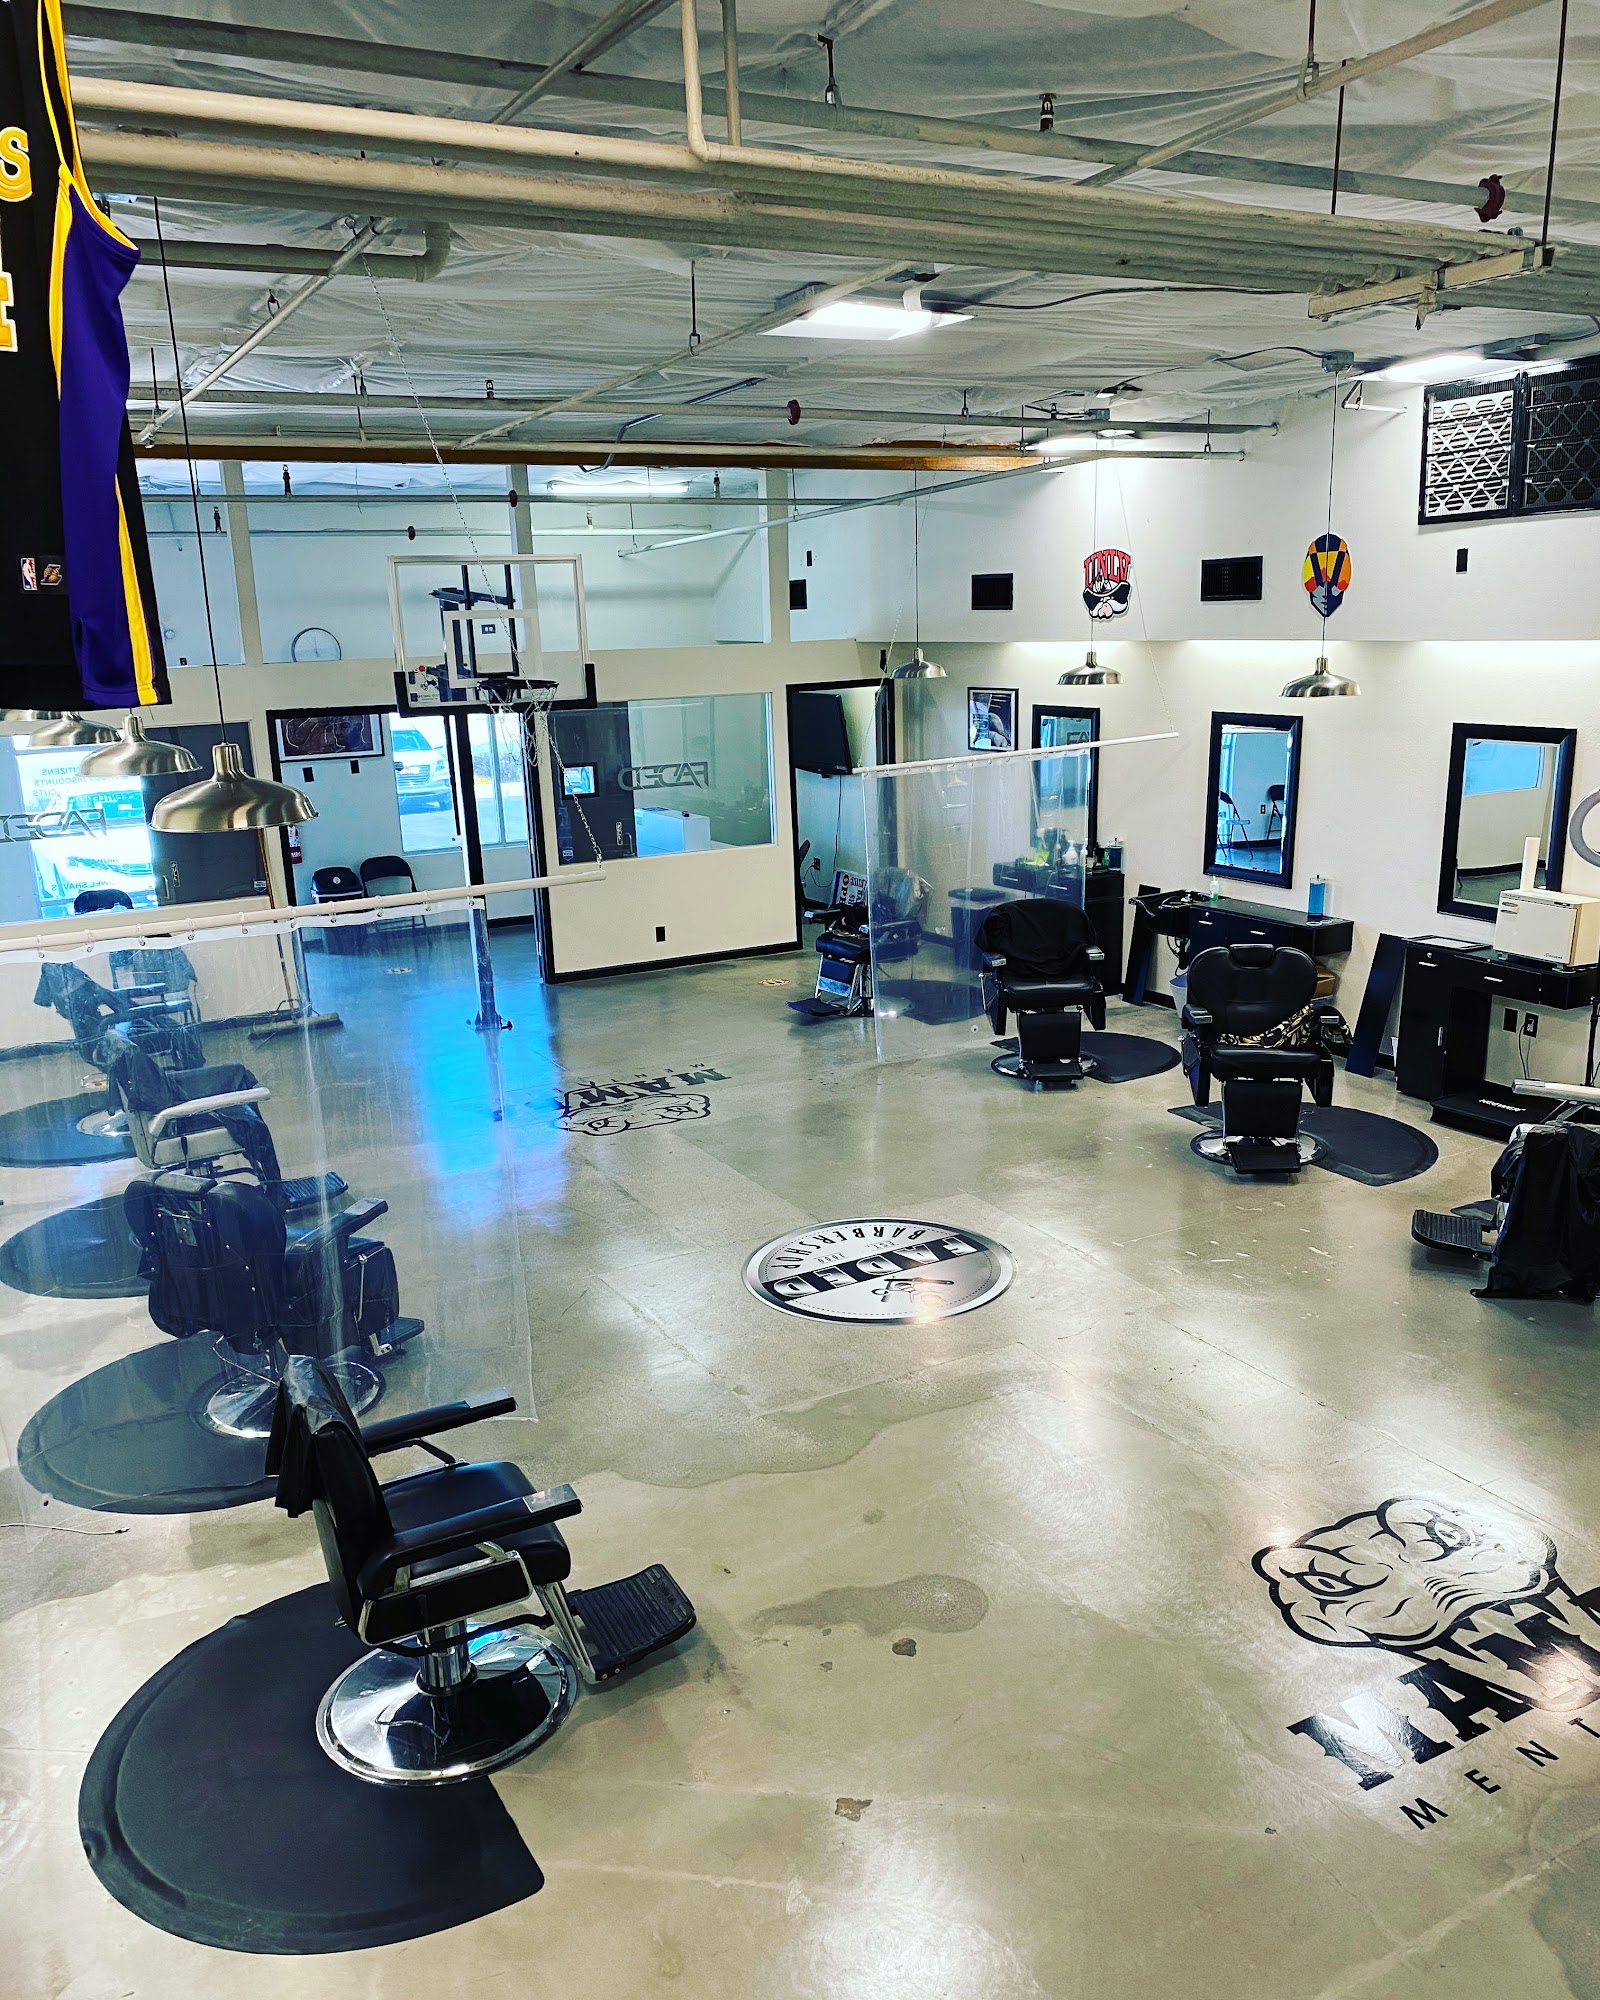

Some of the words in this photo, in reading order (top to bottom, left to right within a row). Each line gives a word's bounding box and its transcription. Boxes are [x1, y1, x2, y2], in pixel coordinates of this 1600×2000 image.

[1083, 548, 1131, 589] UNLV
[771, 1226, 927, 1270] BARBERSHOP
[773, 1236, 978, 1297] FADED
[1286, 1586, 1600, 1791] MAM
